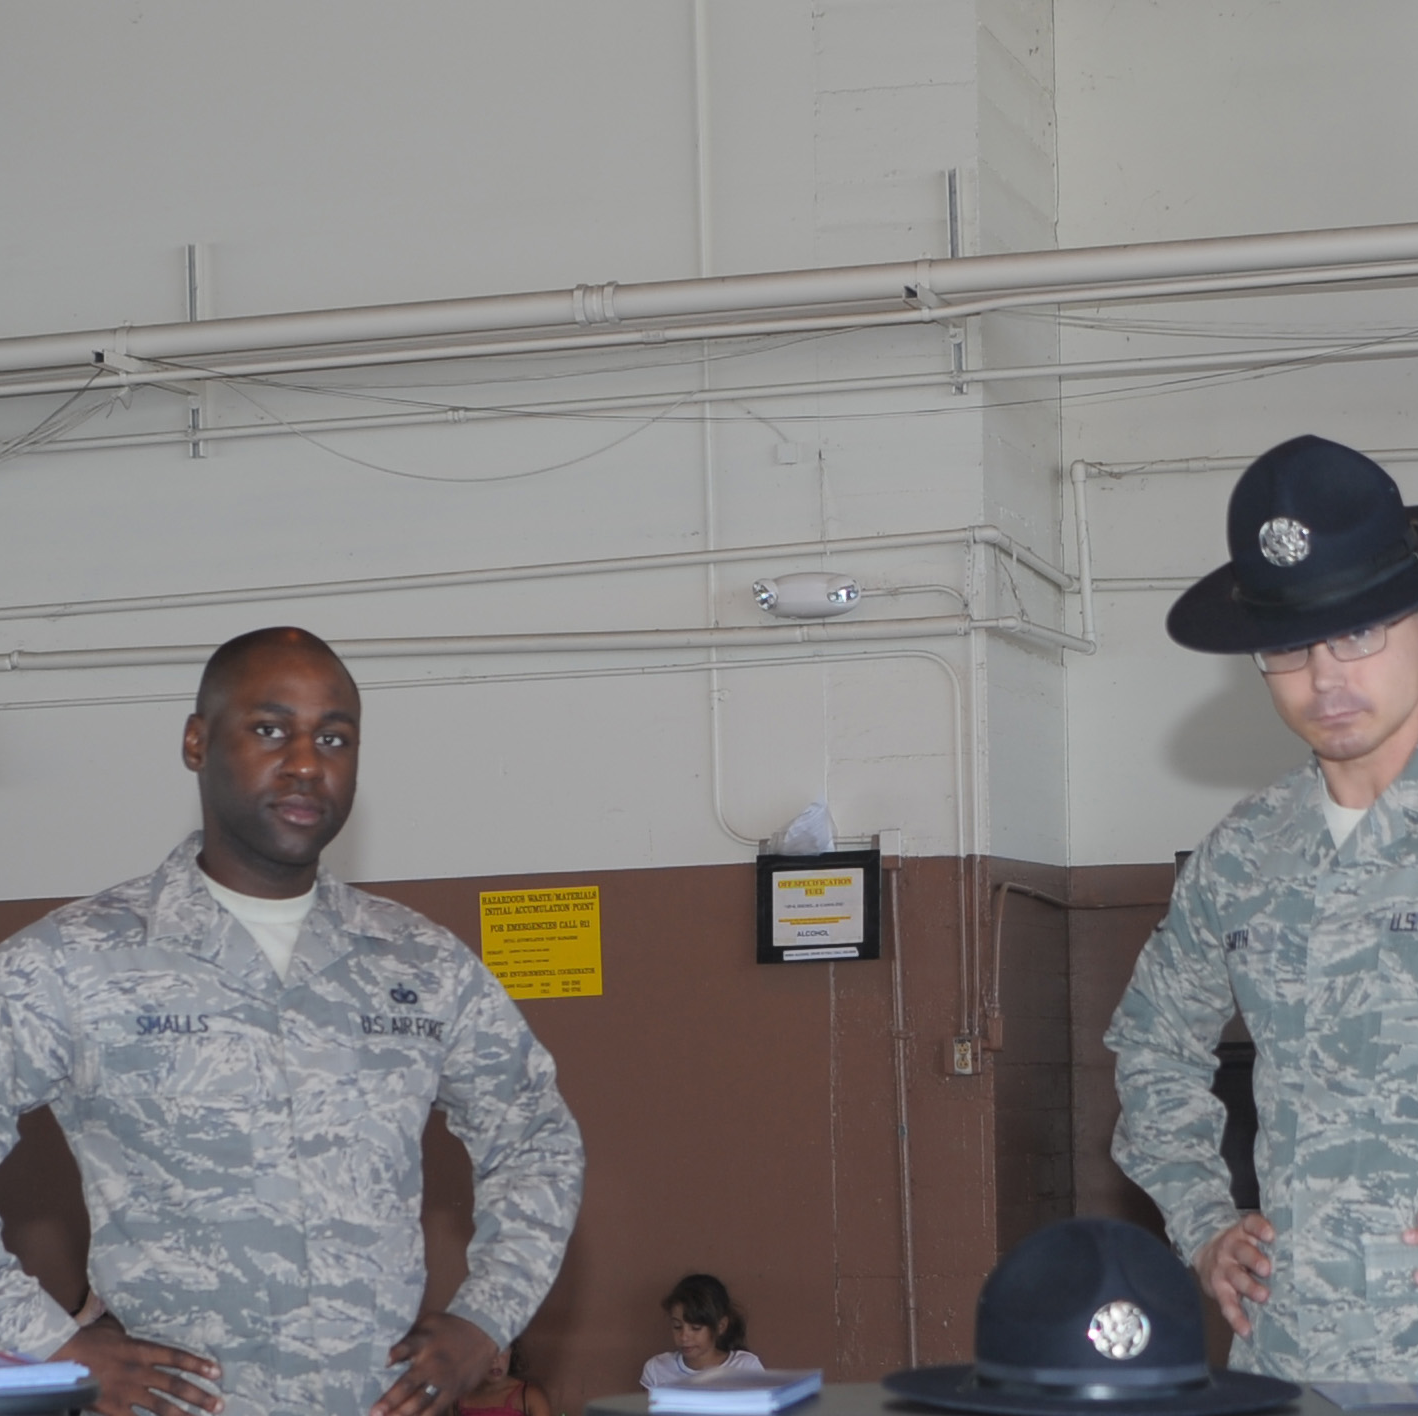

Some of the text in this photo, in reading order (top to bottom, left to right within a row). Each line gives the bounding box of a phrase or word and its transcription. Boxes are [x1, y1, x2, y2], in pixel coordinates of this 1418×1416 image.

[804, 888, 825, 896] FUEL
[482, 895, 525, 905] HAZARDOUS
[485, 902, 594, 916] INITIAL ACCUMULATION POINT
[490, 924, 504, 933] FOR
[506, 921, 557, 932] EMERGENCIES
[559, 920, 578, 929] CALL
[1390, 911, 1417, 932] U.S.
[136, 1014, 209, 1035] SMALLS
[391, 1016, 415, 1036] AIR
